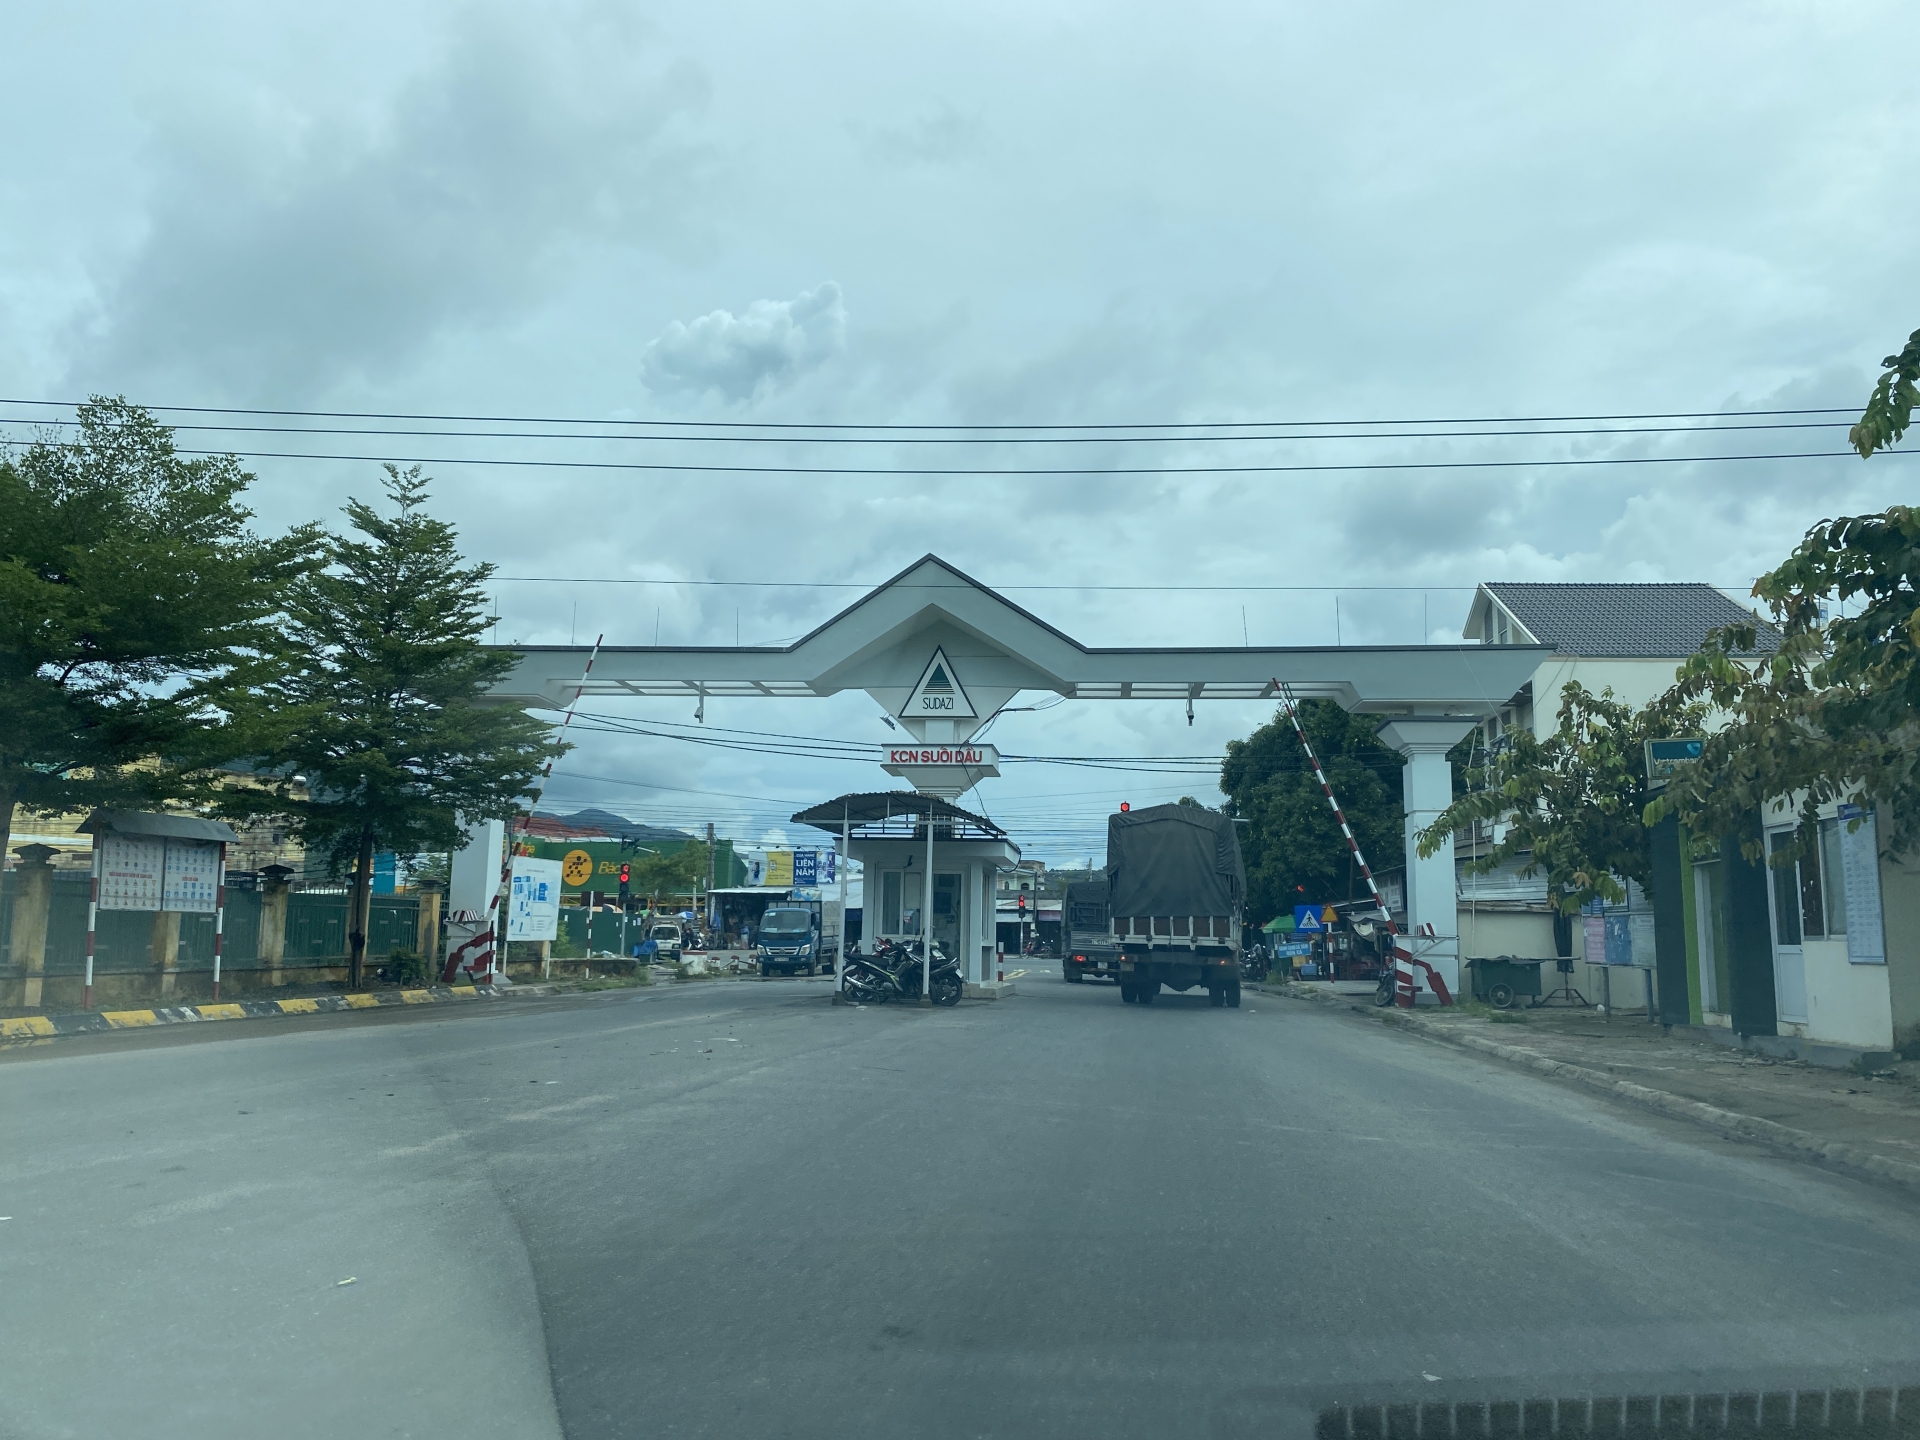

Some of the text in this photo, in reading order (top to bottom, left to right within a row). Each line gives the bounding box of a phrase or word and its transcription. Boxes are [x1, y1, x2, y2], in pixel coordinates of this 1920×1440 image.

[923, 697, 954, 710] SUDAZI
[890, 750, 918, 763] KCN
[955, 746, 983, 763] DẦU
[796, 858, 814, 867] LIÊN
[796, 866, 815, 876] NĂM
